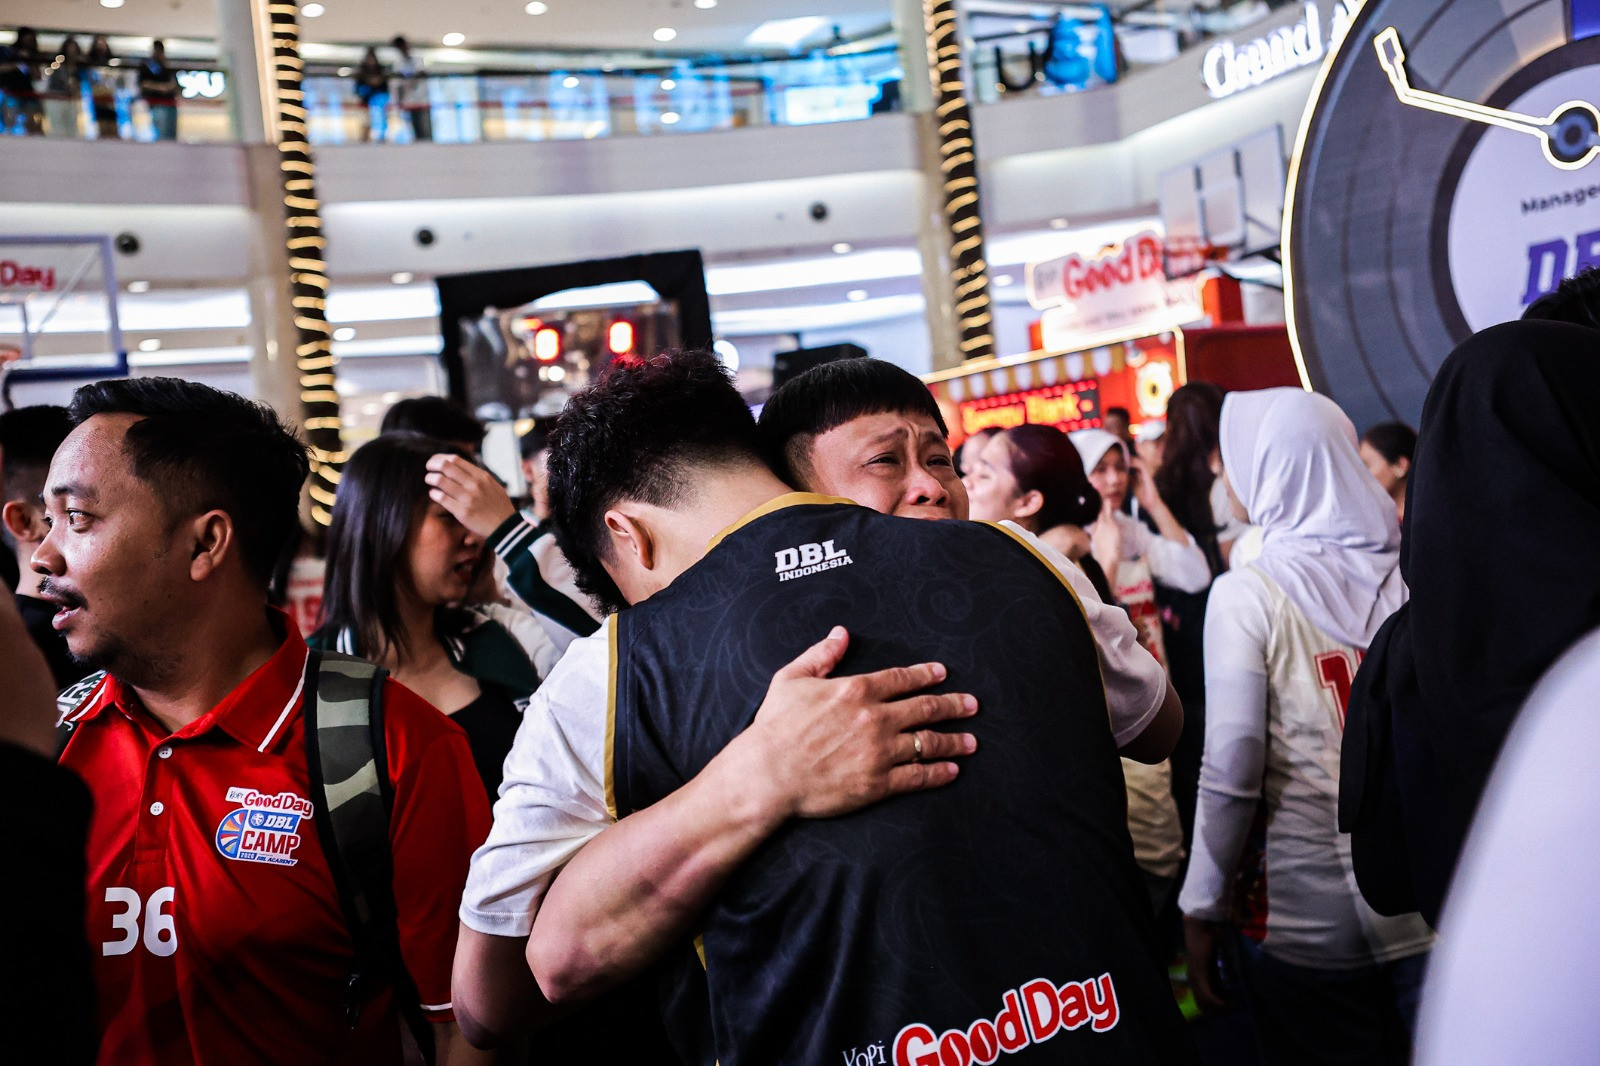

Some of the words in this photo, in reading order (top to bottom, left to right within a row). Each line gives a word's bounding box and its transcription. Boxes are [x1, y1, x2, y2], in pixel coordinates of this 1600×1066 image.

[775, 539, 847, 573] DBL
[779, 556, 853, 582] INDONESIA
[263, 815, 294, 829] DBL
[241, 830, 299, 854] CAMP
[102, 886, 178, 957] 36
